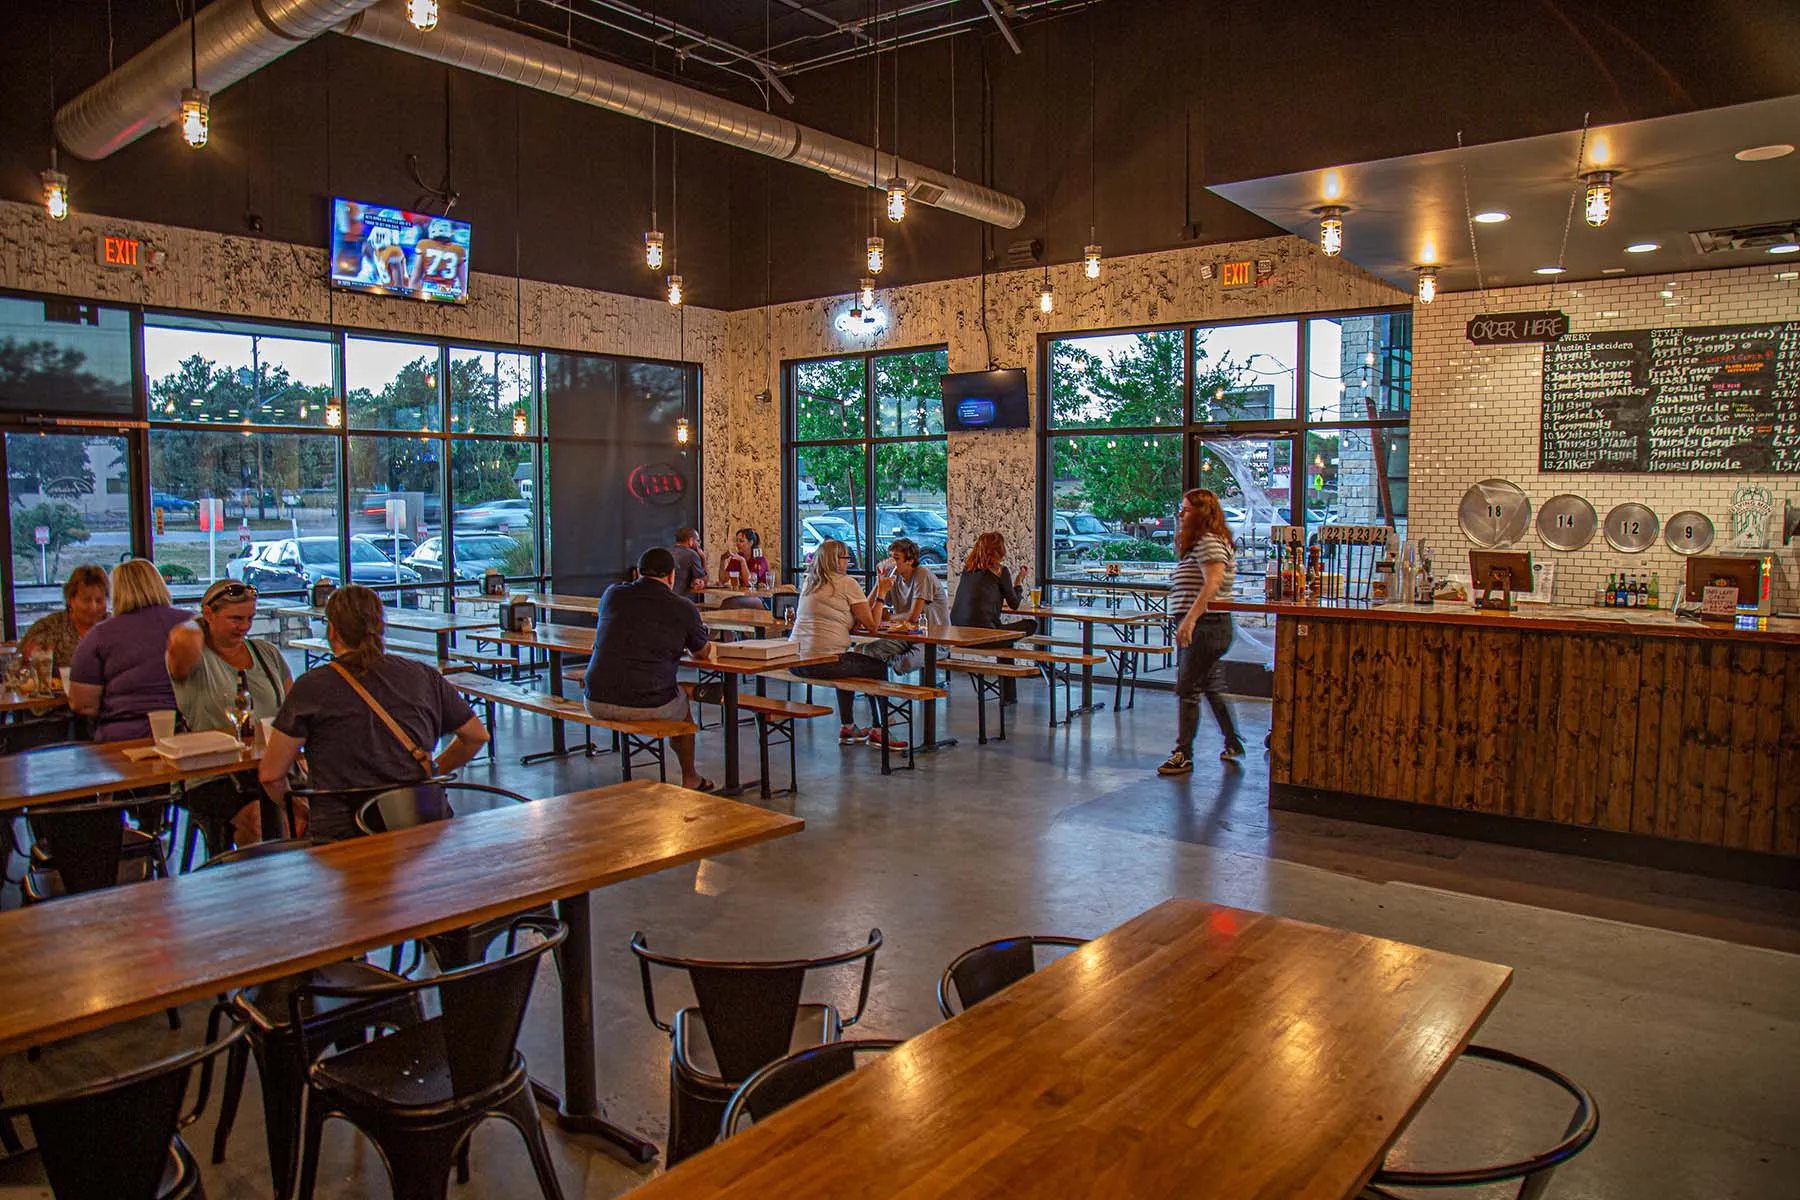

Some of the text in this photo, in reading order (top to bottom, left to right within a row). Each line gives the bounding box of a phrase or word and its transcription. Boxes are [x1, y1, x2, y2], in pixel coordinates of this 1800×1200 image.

[105, 237, 139, 266] EXIT
[425, 248, 458, 279] 73
[1223, 262, 1251, 286] EXIT
[1472, 317, 1563, 340] ORDER HERE
[1650, 328, 1684, 338] STYLE
[1559, 333, 1592, 342] WERY
[1651, 336, 1680, 349] Brut
[1554, 343, 1583, 352] Austin
[1585, 342, 1633, 351] Eastciders
[1692, 341, 1736, 355] Bomb
[1555, 351, 1592, 362] Argus
[1555, 361, 1589, 371] Texas
[1590, 360, 1634, 371] Keeper
[1551, 370, 1632, 382] Independence
[1551, 379, 1632, 391] Independence
[1660, 383, 1706, 394] Rosalie
[1551, 389, 1605, 402] Firestone
[1605, 386, 1649, 397] Walker
[1552, 409, 1593, 421] Twisted
[1595, 408, 1605, 419] X
[1650, 402, 1730, 416] Barleysicle
[1553, 419, 1612, 431] Community
[1649, 425, 1686, 437] Velvet
[1554, 429, 1626, 440] Whitestone
[1556, 439, 1598, 449] Thirsty
[1599, 435, 1638, 449] Planet
[1648, 437, 1700, 449] Thirsty
[1557, 449, 1597, 460] Thirsty
[1599, 449, 1638, 460] Planet
[1556, 460, 1595, 471] Zilker
[1648, 458, 1743, 472] Honey Blonde
[1487, 505, 1502, 518] 18
[1558, 514, 1574, 528] 14
[1291, 528, 1298, 541] 6
[1327, 527, 1340, 540] 22
[1357, 528, 1370, 541] 23
[1623, 521, 1640, 535] 12
[1685, 525, 1693, 539] 9
[1108, 564, 1118, 574] 24
